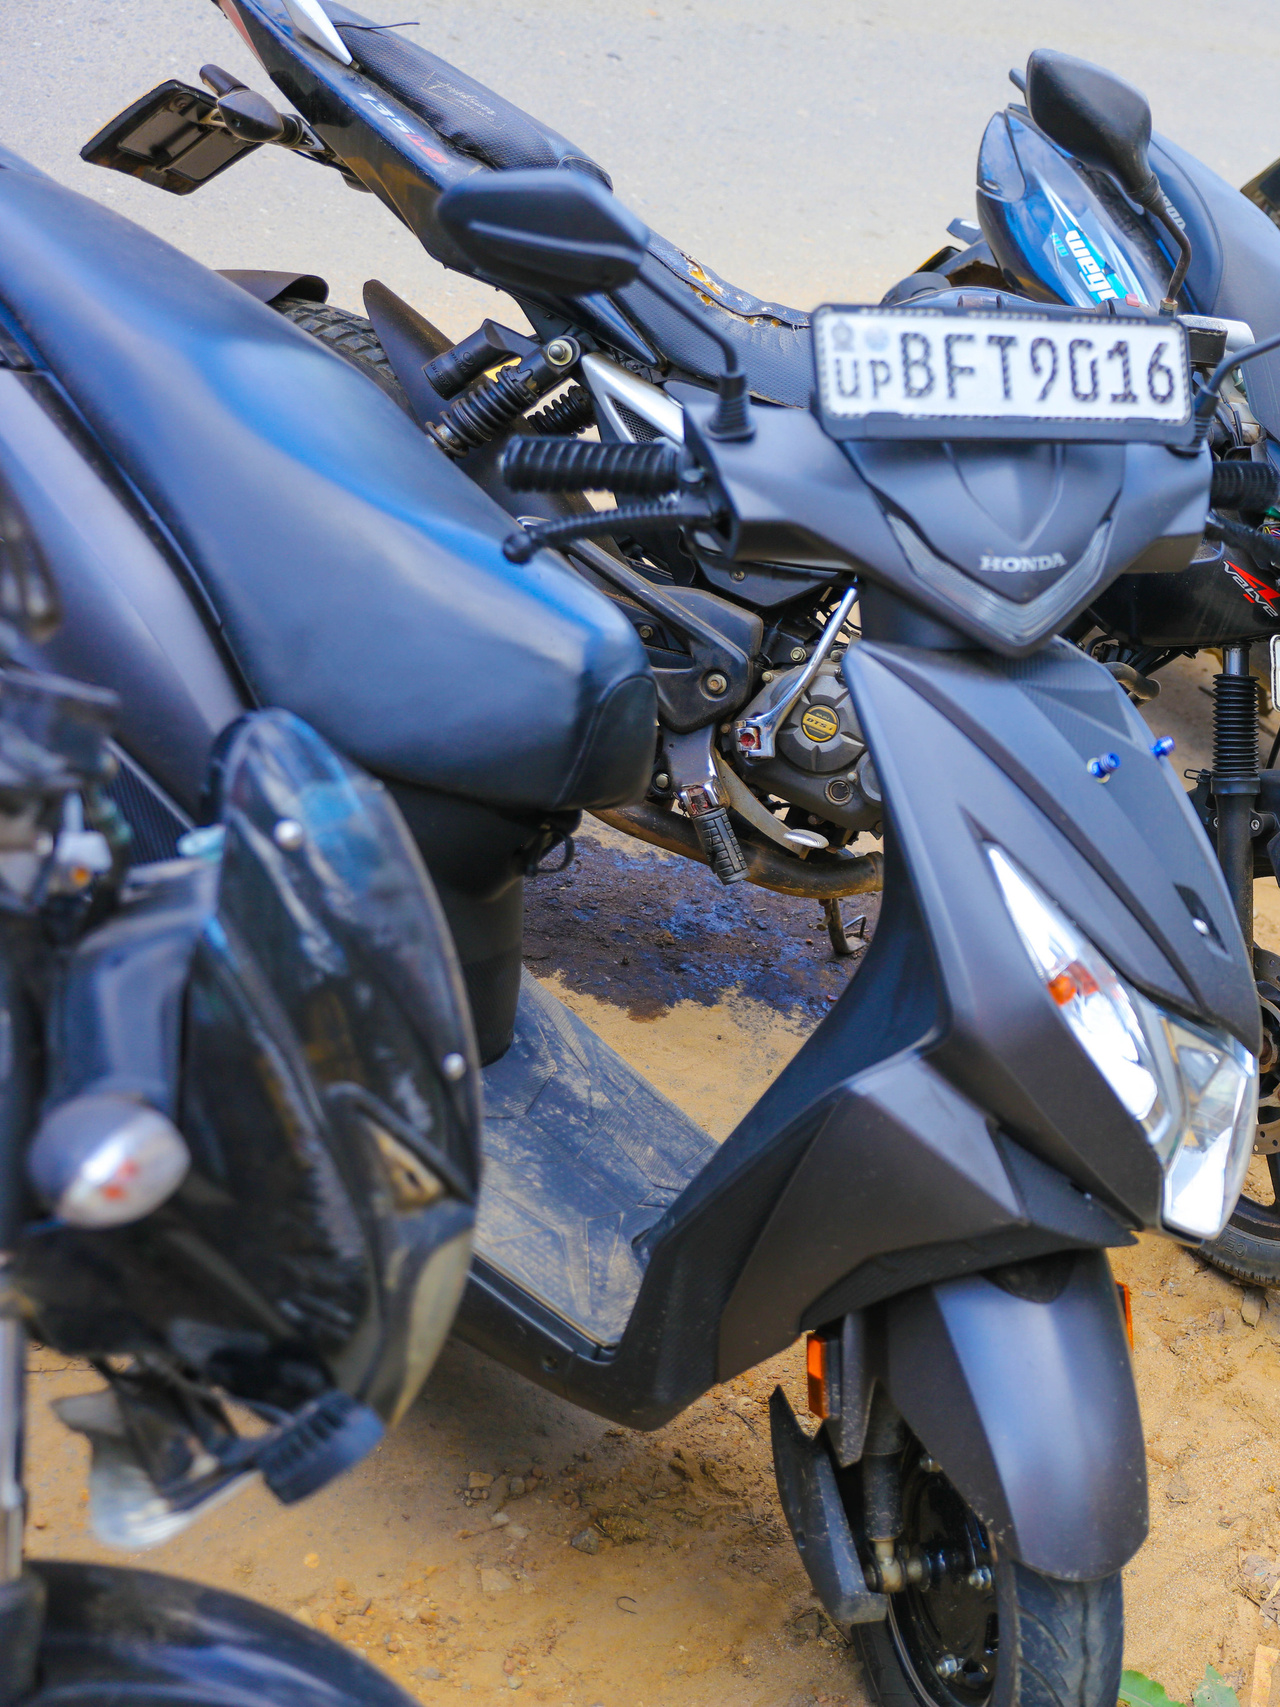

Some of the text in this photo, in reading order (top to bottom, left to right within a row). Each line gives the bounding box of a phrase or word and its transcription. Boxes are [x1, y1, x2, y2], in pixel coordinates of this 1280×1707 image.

[835, 332, 1175, 405] UP BFT9016
[979, 552, 1067, 573] HONDA
